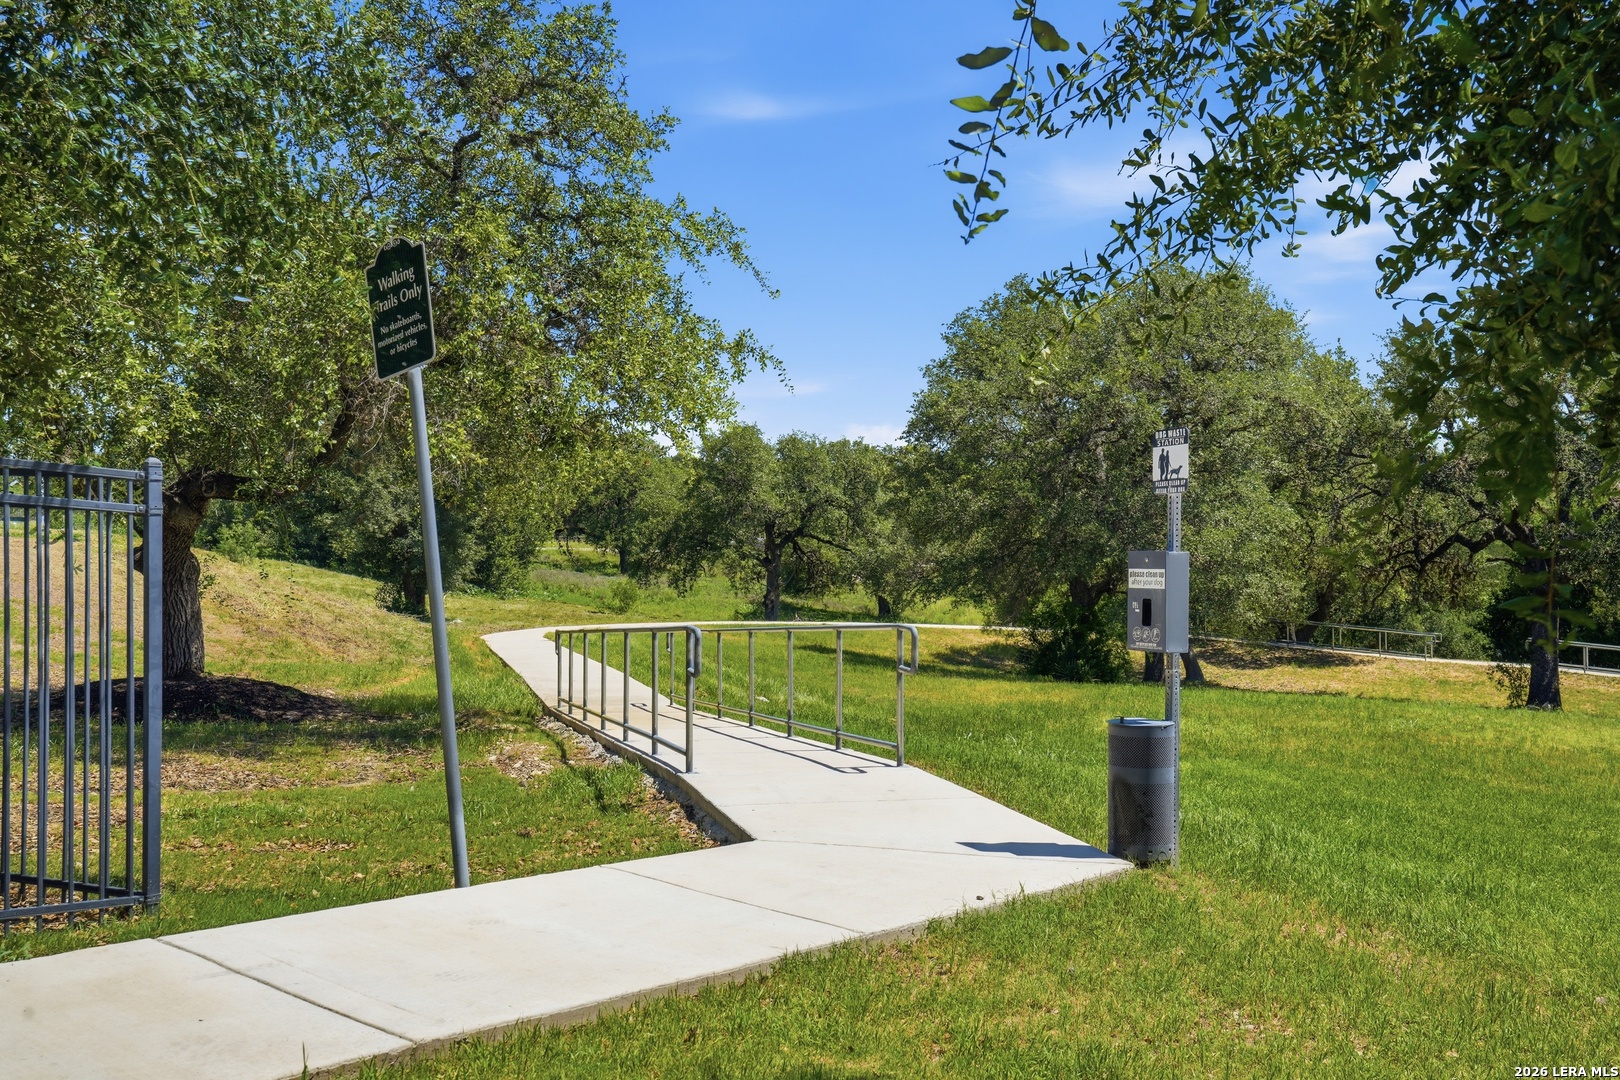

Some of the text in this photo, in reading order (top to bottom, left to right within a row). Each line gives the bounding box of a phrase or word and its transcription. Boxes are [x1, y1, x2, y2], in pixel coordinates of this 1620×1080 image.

[377, 266, 415, 292] Walking
[399, 282, 423, 303] Only
[380, 326, 389, 335] No
[389, 338, 418, 355] or bicycles
[1168, 428, 1186, 438] WASTE
[1157, 438, 1185, 447] STATION
[1129, 570, 1145, 579] please
[1145, 570, 1158, 578] clean
[1142, 579, 1153, 587] your
[1154, 579, 1163, 587] dog
